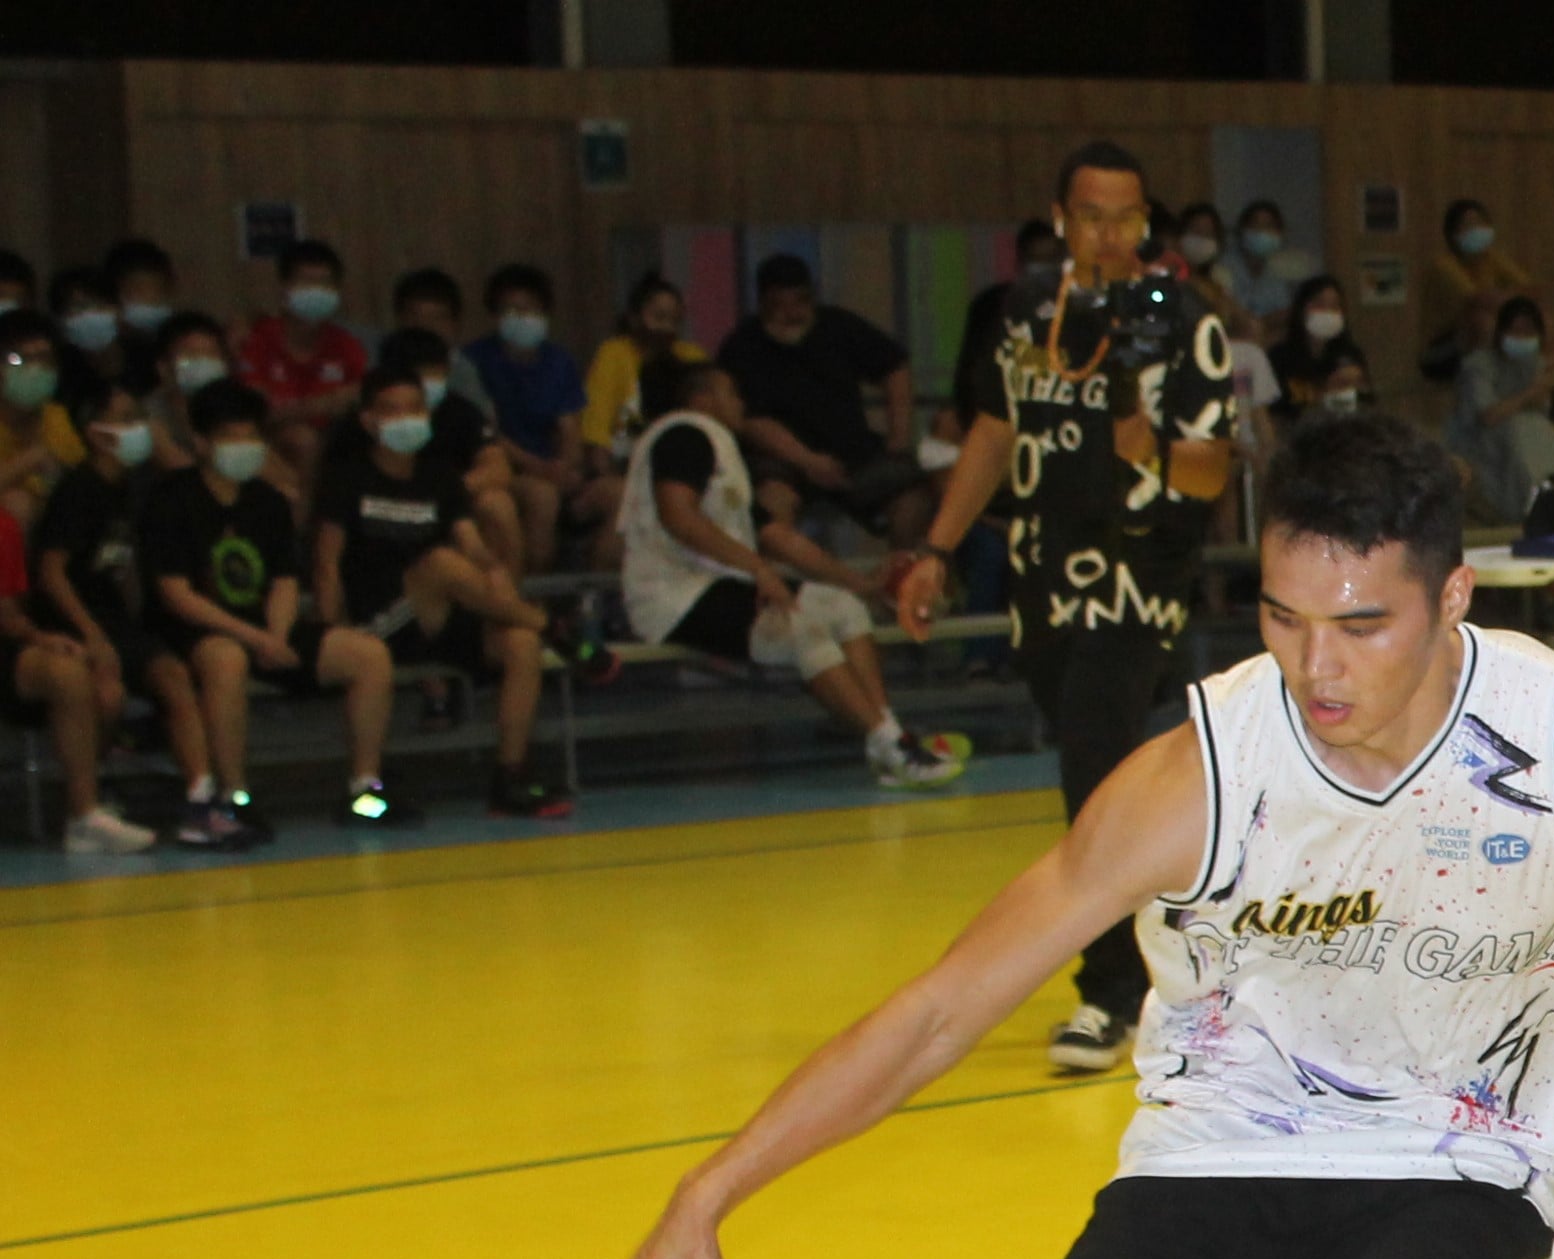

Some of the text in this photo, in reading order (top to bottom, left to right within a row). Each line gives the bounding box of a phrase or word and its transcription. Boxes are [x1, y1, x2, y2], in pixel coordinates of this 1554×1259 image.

[1421, 825, 1471, 838] EXPLORE
[1437, 838, 1471, 849] YOUR
[1485, 839, 1526, 860] IT&E
[1425, 847, 1470, 860] WORLD
[1269, 919, 1401, 974] THE
